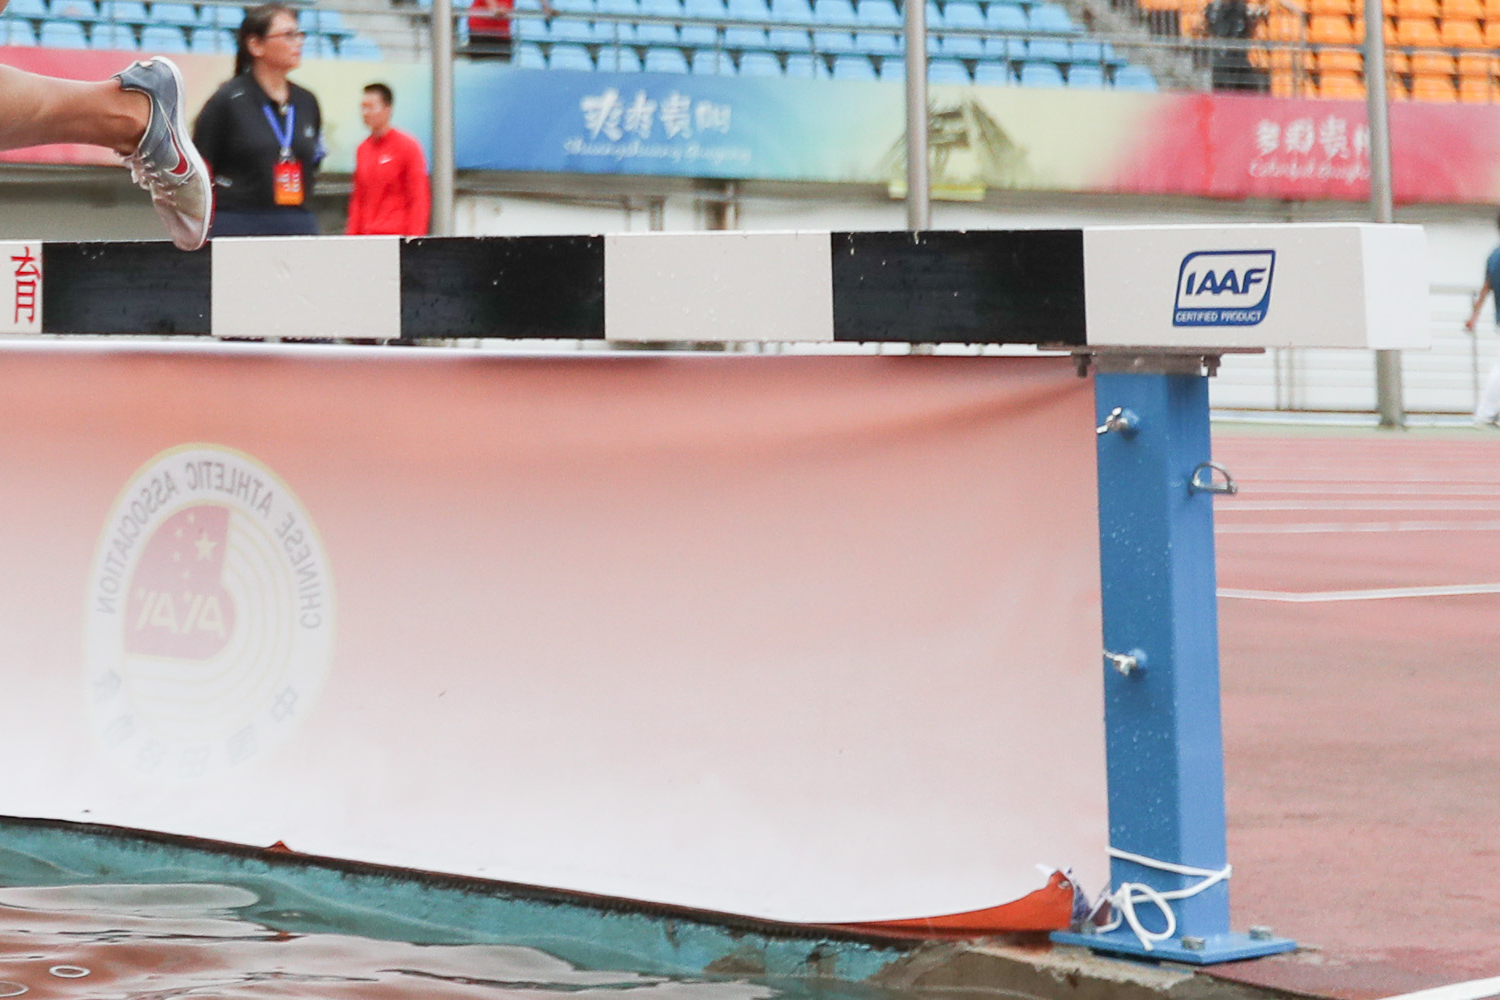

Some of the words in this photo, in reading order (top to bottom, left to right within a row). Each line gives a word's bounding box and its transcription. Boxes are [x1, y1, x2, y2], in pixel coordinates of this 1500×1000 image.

[1185, 268, 1267, 296] IAAF
[1175, 310, 1218, 323] CERTIFIED
[1220, 310, 1263, 322] PRODUCT
